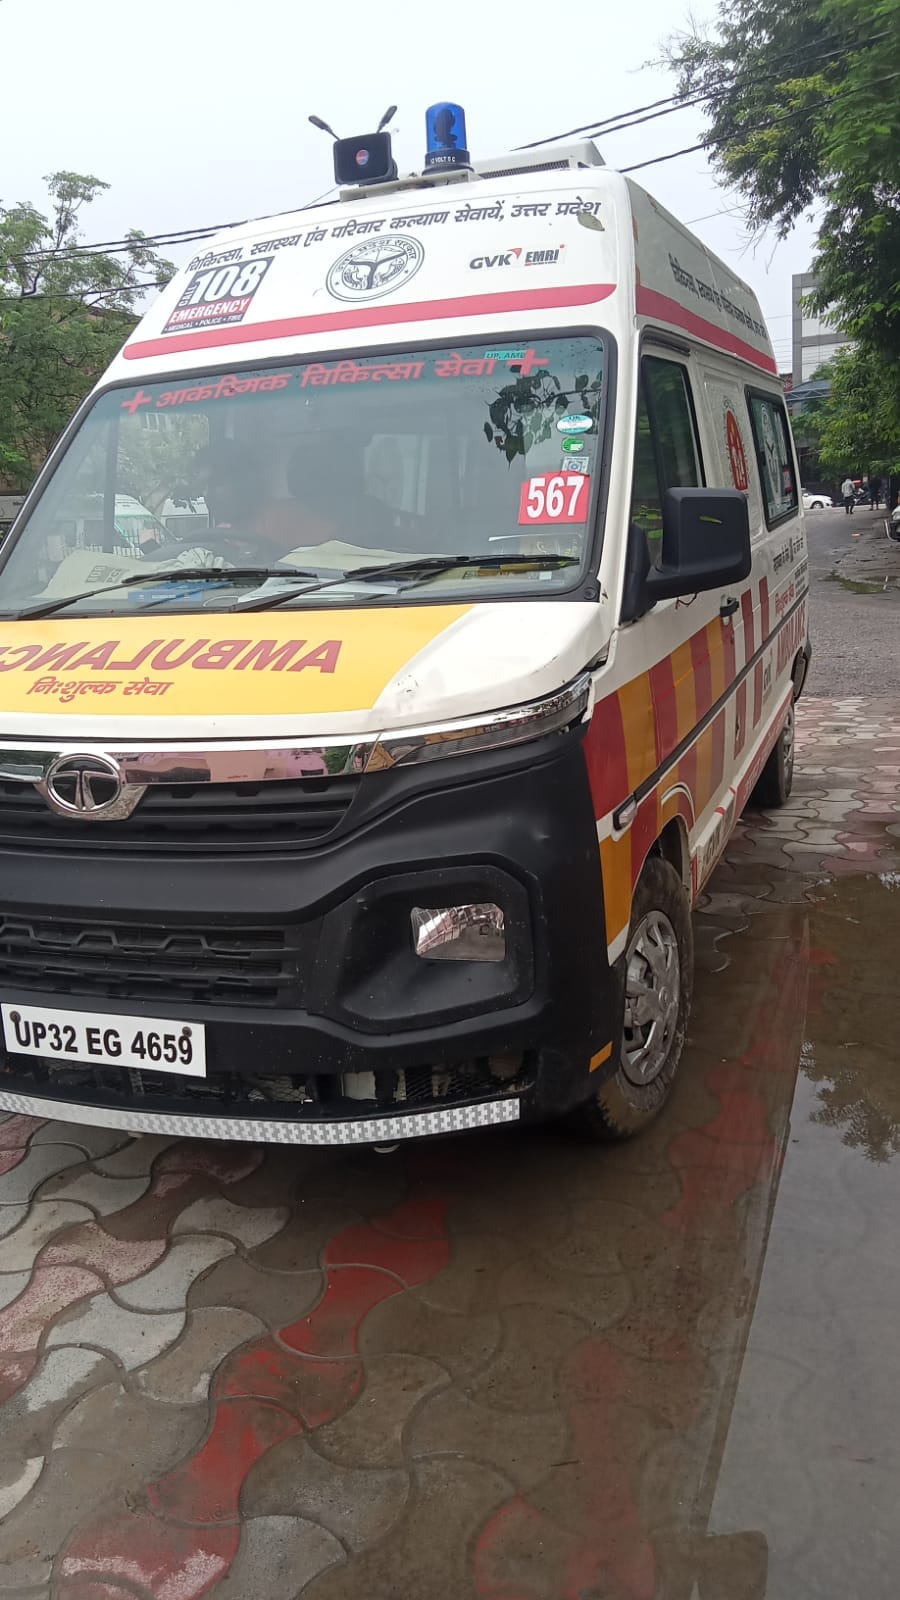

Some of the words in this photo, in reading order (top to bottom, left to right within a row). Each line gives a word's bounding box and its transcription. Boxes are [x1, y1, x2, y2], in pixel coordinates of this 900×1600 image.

[185, 247, 243, 274] चिकित्सा,
[250, 233, 302, 256] स्वास्थ्य
[331, 219, 386, 239] परिवार
[390, 211, 450, 230] कल्याण
[455, 200, 505, 222] सेवायें,
[511, 203, 551, 217] उत्तर
[555, 196, 601, 216] प्रदेश
[469, 253, 513, 270] GVK
[525, 249, 560, 263] EMRI
[187, 260, 267, 305] 108
[169, 297, 250, 323] EMERGENCY
[156, 373, 292, 408] आकस्मिक
[301, 361, 425, 387] चिकित्सा
[435, 353, 496, 378] सेवा
[526, 475, 585, 519] 567
[26, 676, 122, 703] निःशुल्क
[122, 677, 174, 696] सेवा
[13, 1019, 78, 1052] UP32
[86, 1027, 122, 1057] EG
[131, 1031, 193, 1065] 4659
